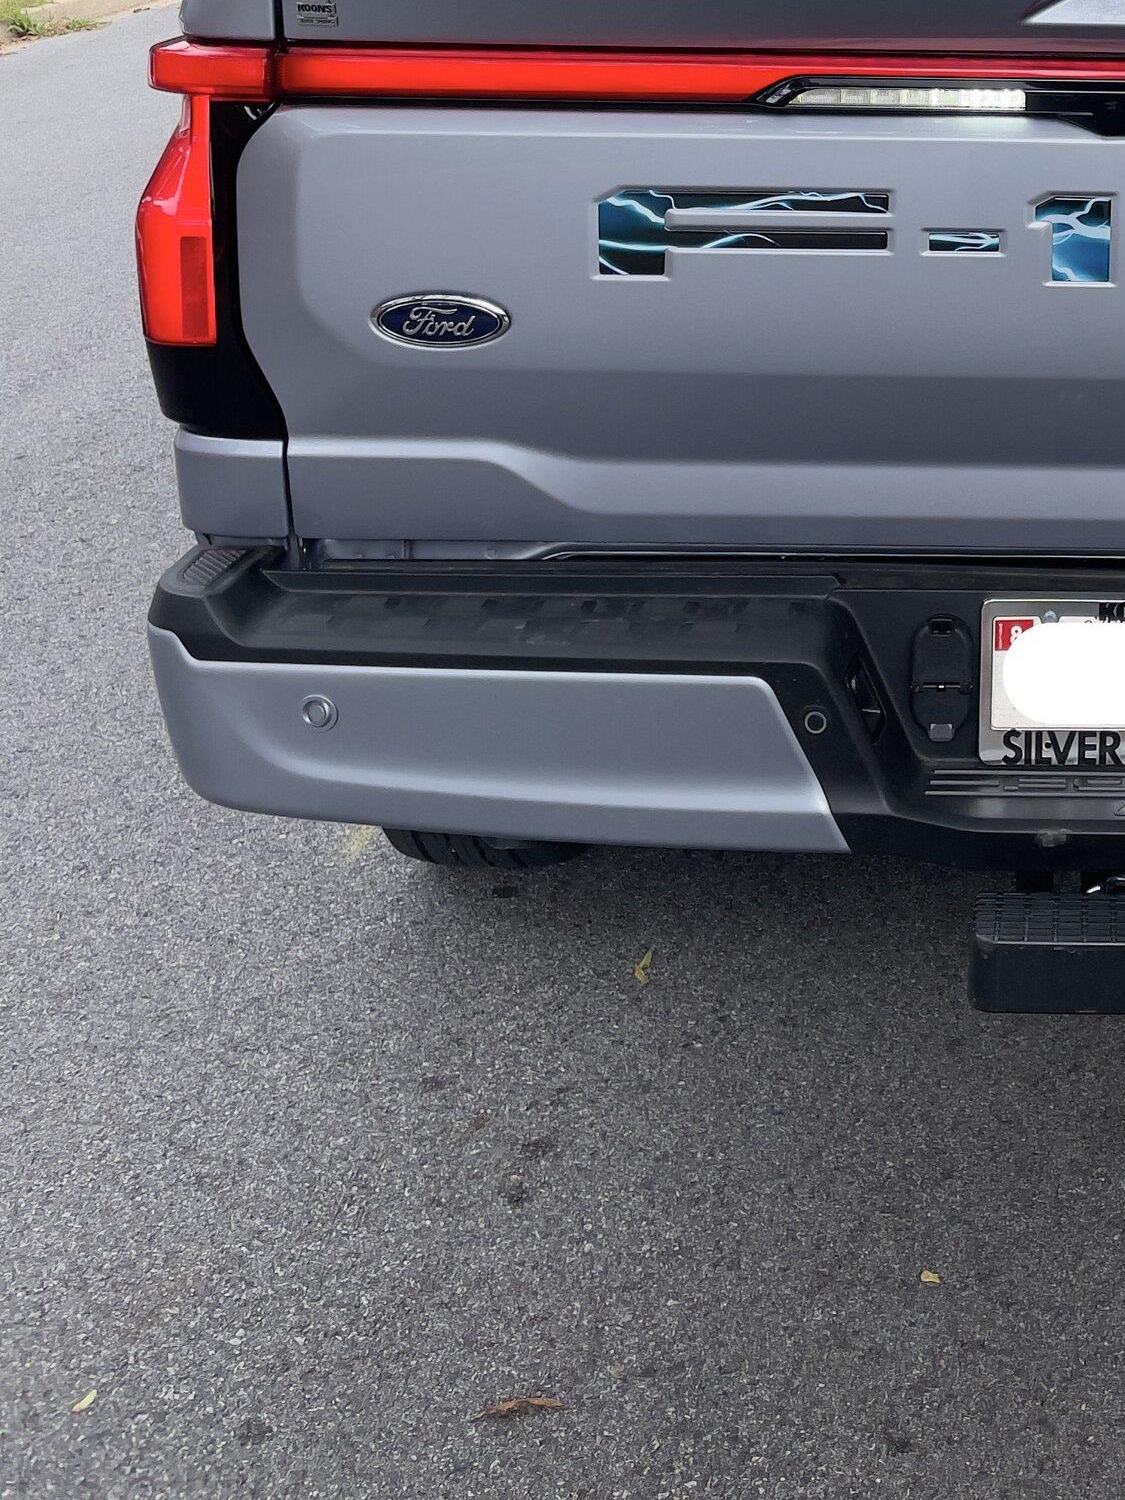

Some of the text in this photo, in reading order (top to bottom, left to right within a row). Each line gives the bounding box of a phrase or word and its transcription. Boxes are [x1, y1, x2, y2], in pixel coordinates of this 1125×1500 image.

[297, 4, 332, 13] KOONS
[402, 306, 476, 337] Ford
[1001, 729, 1122, 766] SILVER
